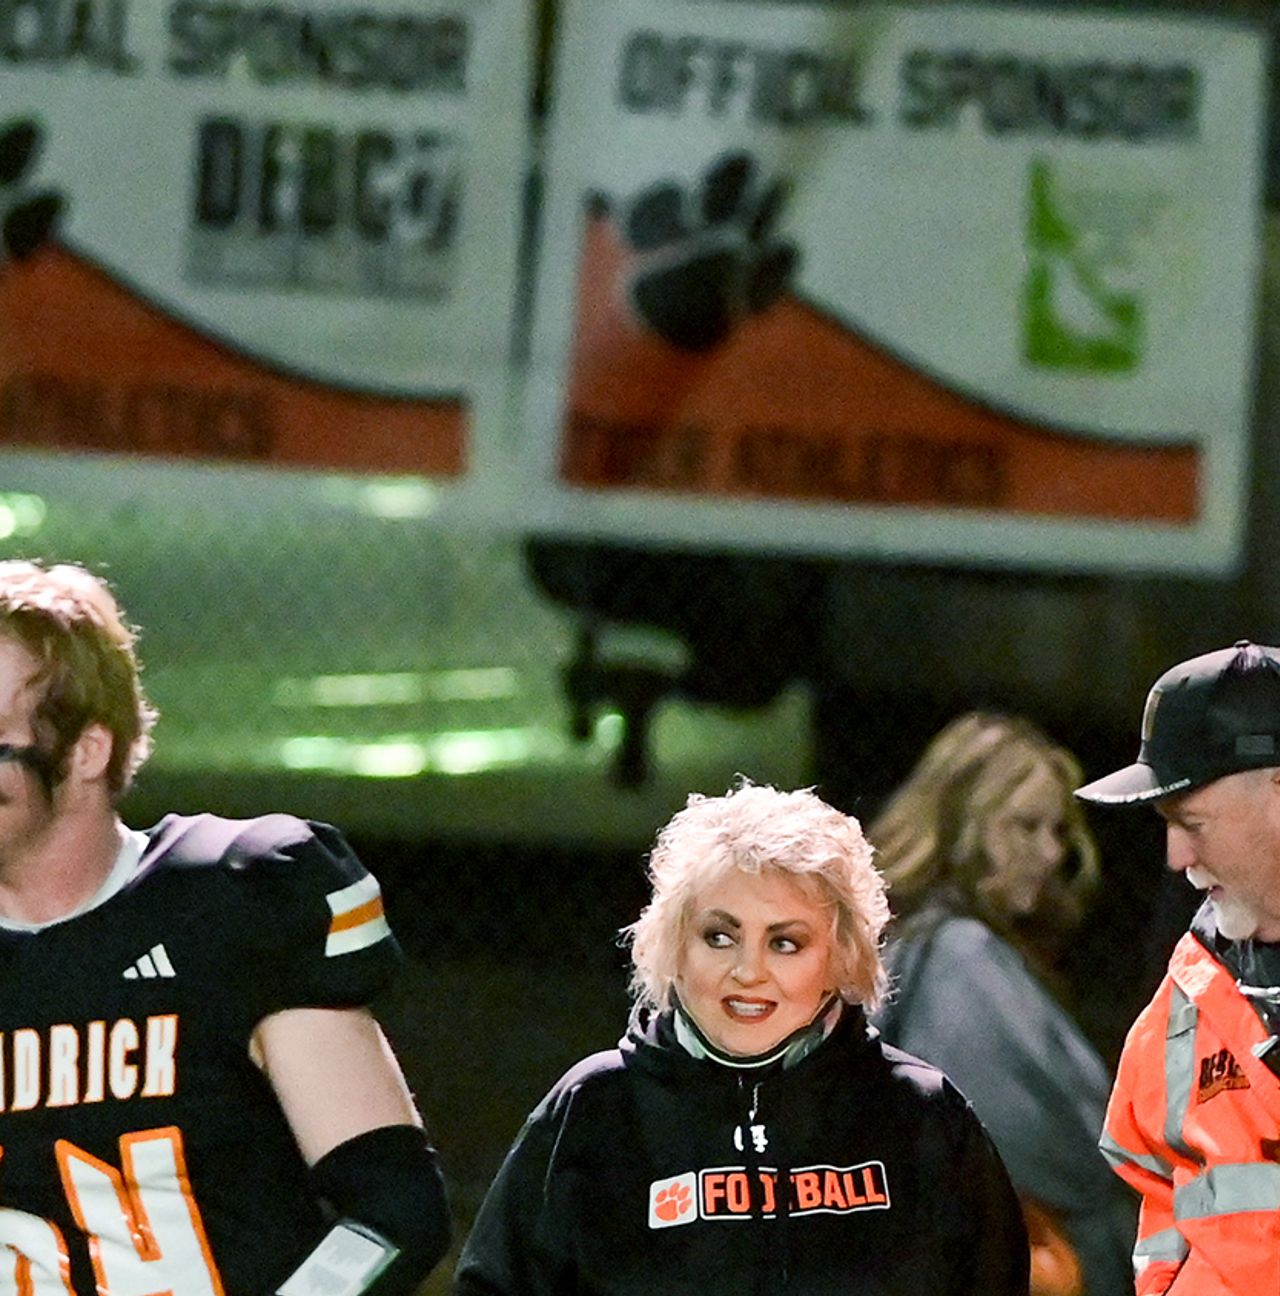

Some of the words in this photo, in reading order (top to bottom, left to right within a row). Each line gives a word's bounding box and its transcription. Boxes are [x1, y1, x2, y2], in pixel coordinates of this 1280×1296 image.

[619, 32, 874, 127] OFFICIAL
[898, 48, 1203, 142] SPONSOR
[704, 1167, 886, 1214] FOOBALL
